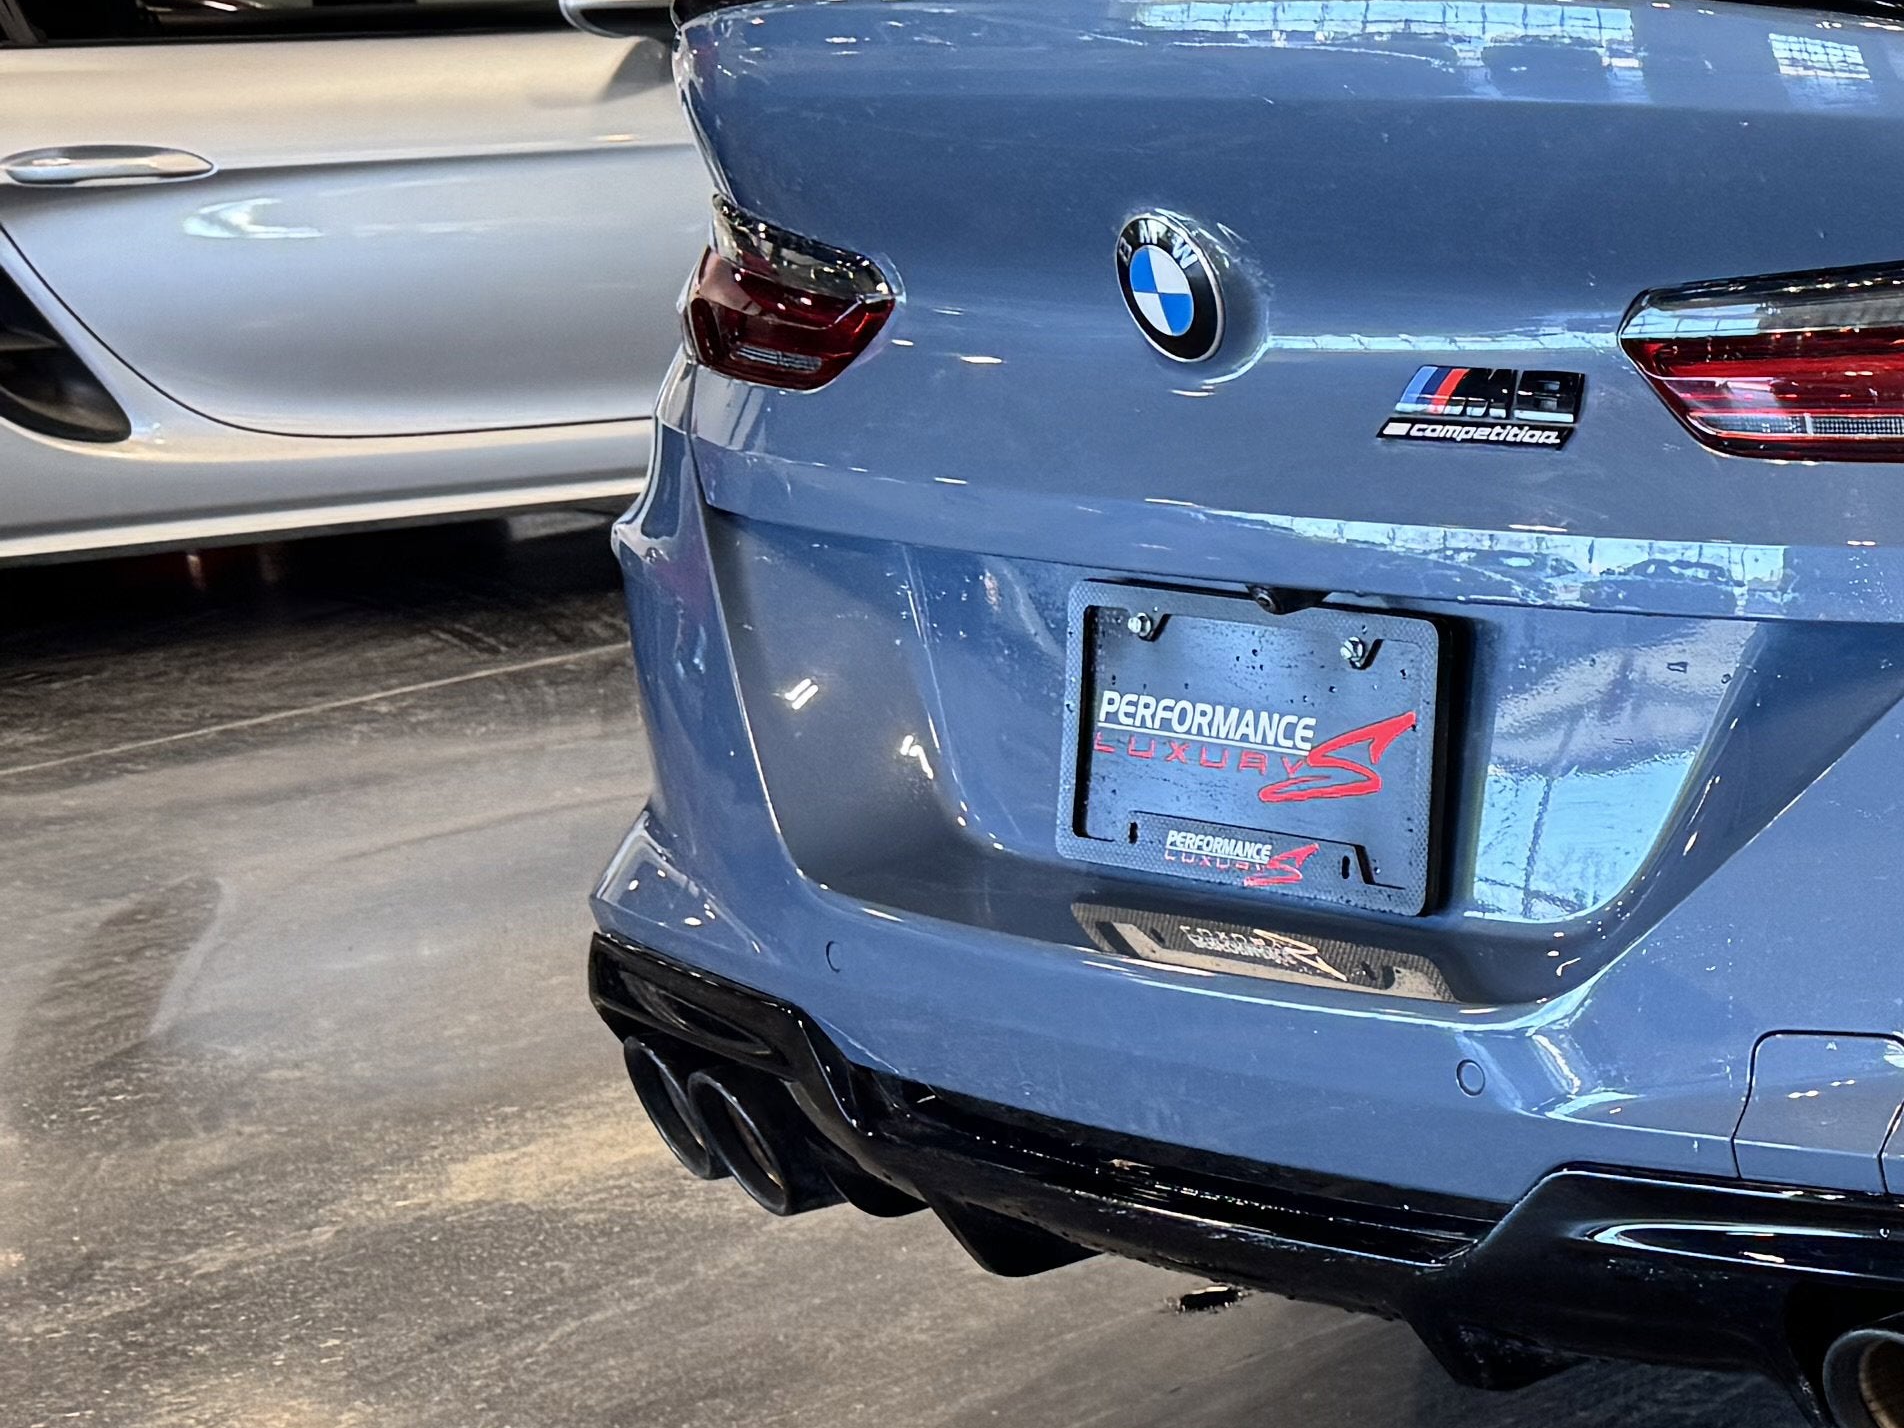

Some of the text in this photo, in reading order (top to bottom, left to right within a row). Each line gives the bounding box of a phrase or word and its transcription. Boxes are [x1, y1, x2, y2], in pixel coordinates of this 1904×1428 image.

[1117, 219, 1199, 270] BMW
[1409, 422, 1561, 445] competition
[1099, 690, 1317, 751] PERFORMANCE
[1093, 731, 1305, 779] LUXURY
[1166, 829, 1273, 860] PERFORMANCE
